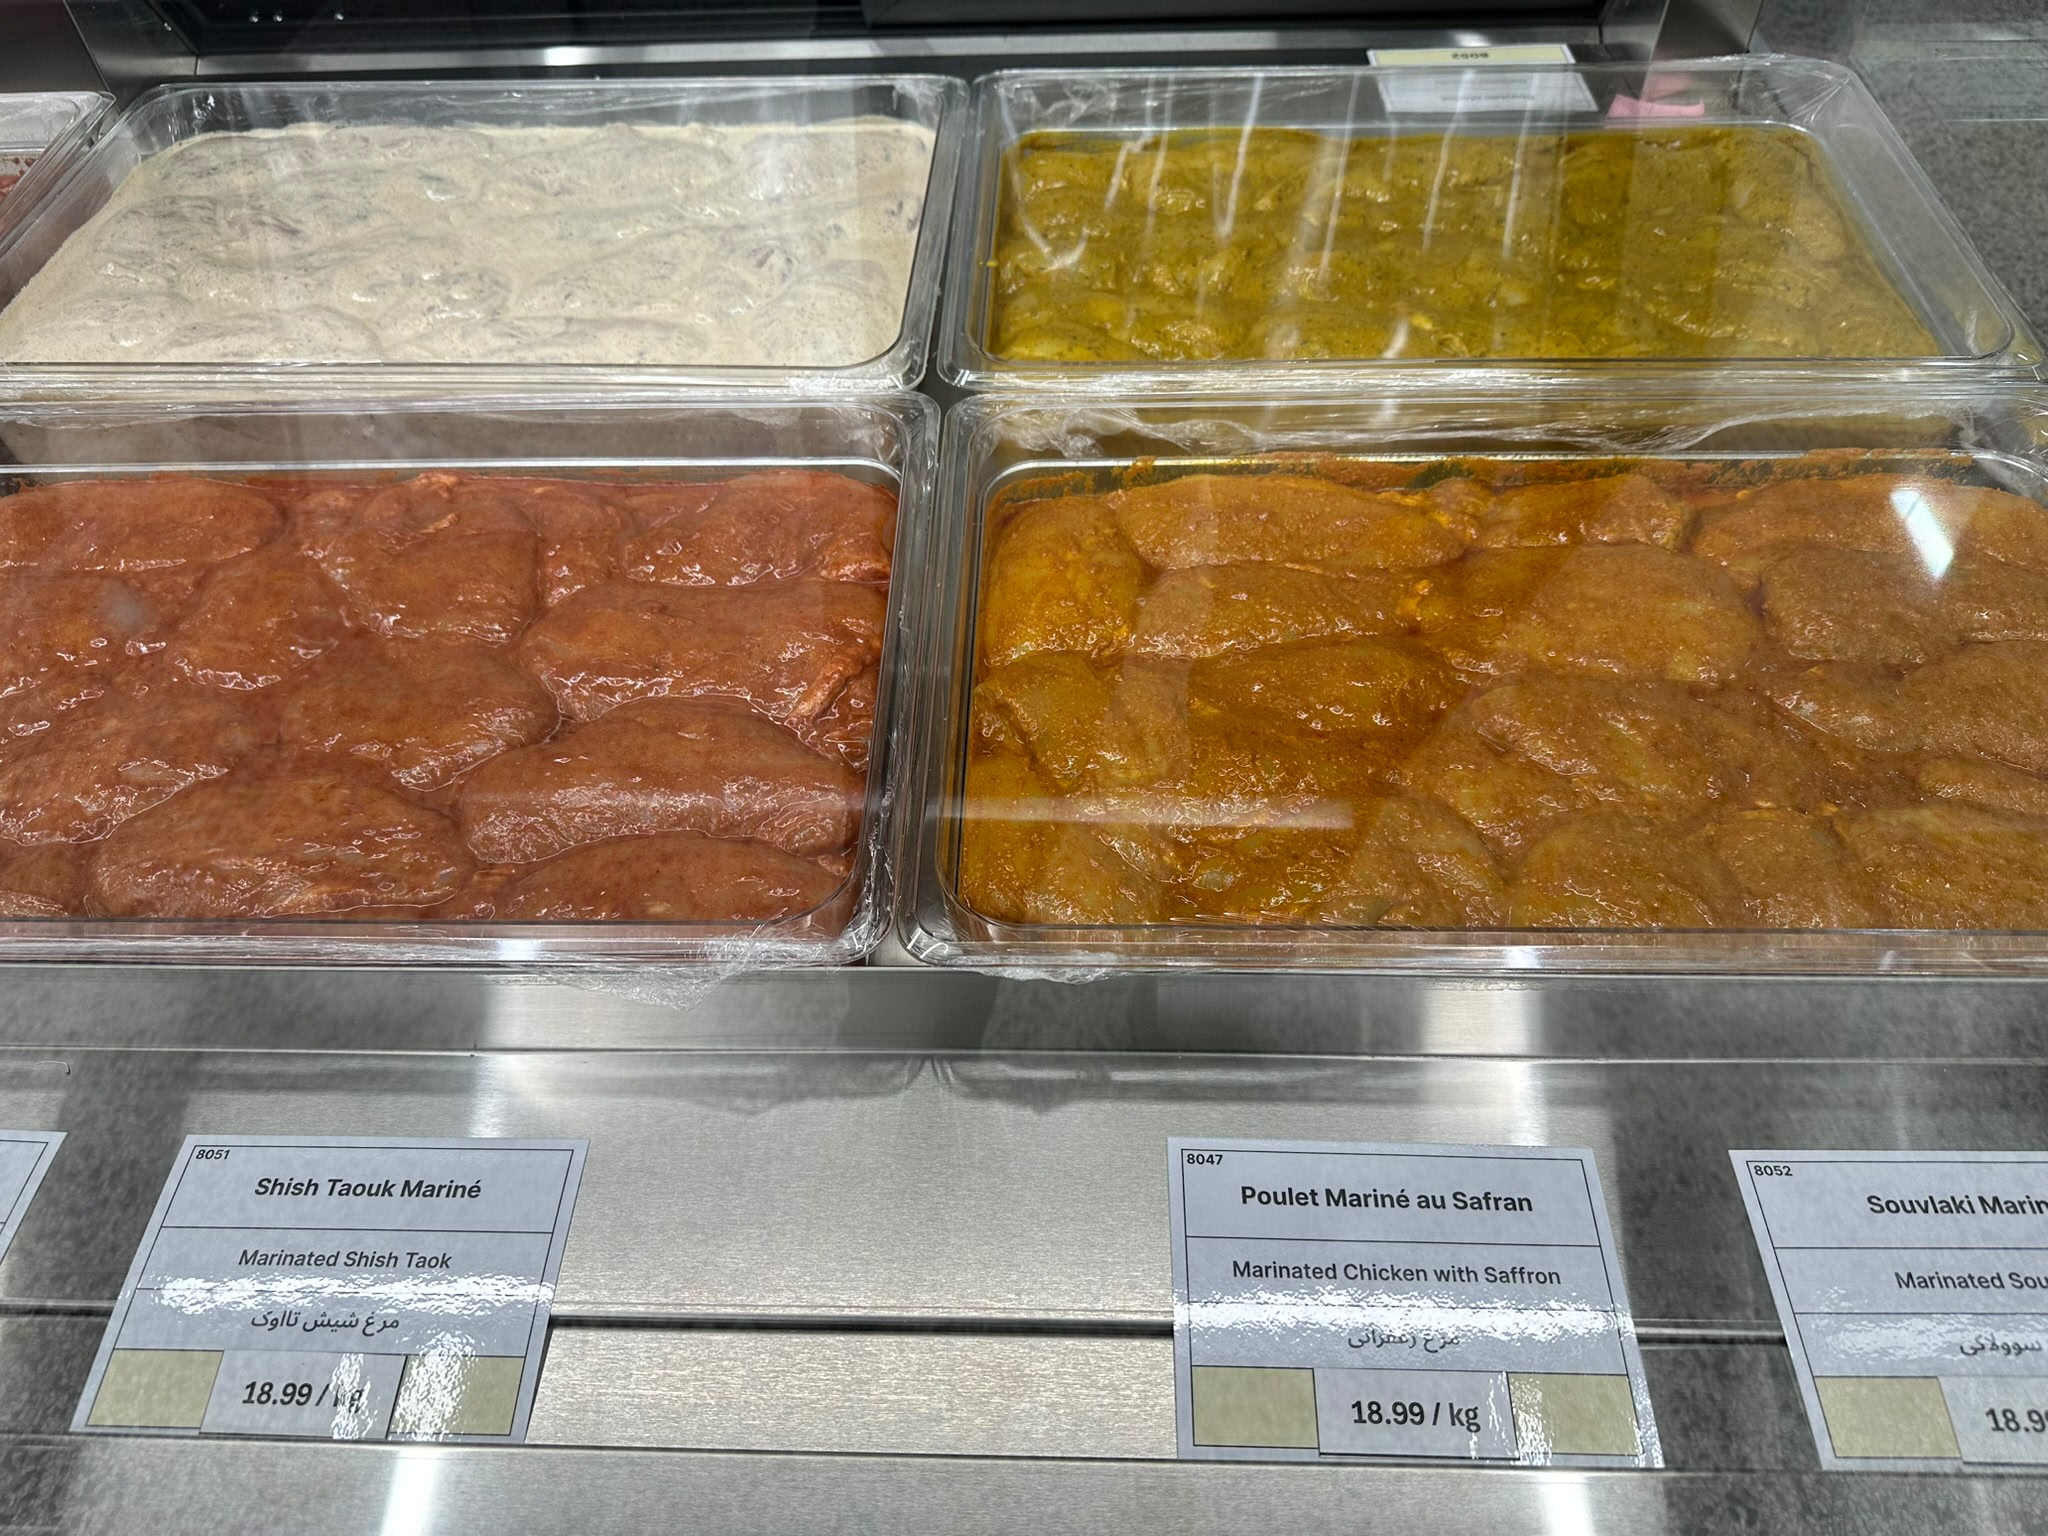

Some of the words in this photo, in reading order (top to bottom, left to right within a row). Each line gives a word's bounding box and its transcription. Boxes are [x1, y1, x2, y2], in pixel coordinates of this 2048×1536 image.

[195, 1148, 231, 1161] 8051
[1186, 1153, 1224, 1166] 8047
[1753, 1165, 1793, 1178] 8052
[254, 1177, 319, 1197] Shish
[326, 1178, 397, 1198] Taouk
[400, 1178, 482, 1199] Mariné
[1240, 1185, 1320, 1207] Poulet
[1325, 1187, 1410, 1209] Mariné
[1416, 1194, 1447, 1210] au
[1452, 1190, 1534, 1212] Safran
[1866, 1194, 1976, 1215] Souvlaki
[237, 1249, 340, 1268] Marinated
[343, 1250, 399, 1269] Shish
[405, 1252, 453, 1269] Taok
[1232, 1260, 1337, 1281] Marinated
[1343, 1262, 1428, 1283] Chicken
[1433, 1263, 1480, 1284] with
[1484, 1265, 1561, 1286] Saffron
[1894, 1271, 2005, 1290] Marinated
[362, 1311, 400, 1338] مرغ
[242, 1380, 313, 1407] 18.99
[314, 1382, 331, 1407] /
[1351, 1399, 1425, 1426] 18.99
[1431, 1401, 1441, 1426] /
[1448, 1401, 1481, 1434] kg
[1985, 1406, 2048, 1433] 18.9
